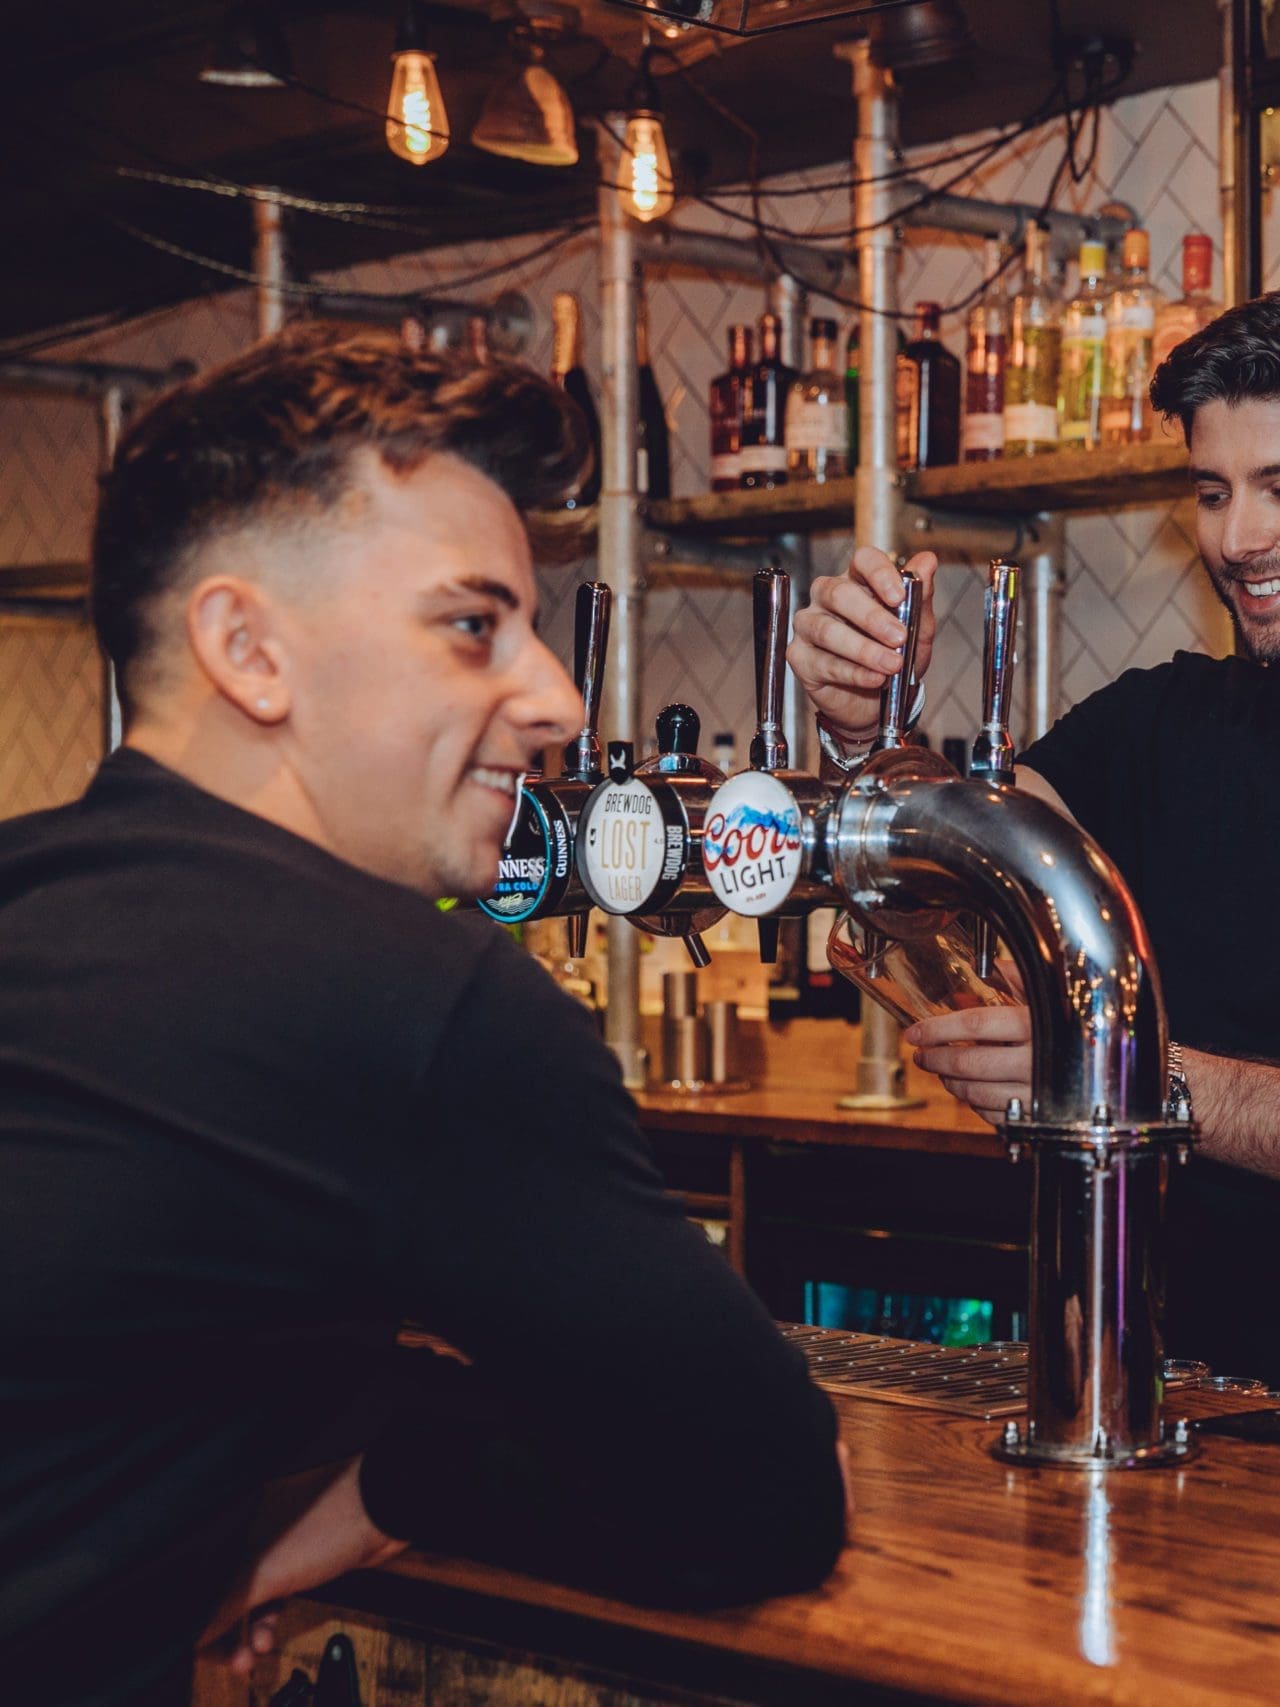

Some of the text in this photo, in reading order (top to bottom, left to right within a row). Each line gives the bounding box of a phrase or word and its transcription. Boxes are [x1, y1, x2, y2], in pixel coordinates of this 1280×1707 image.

[605, 793, 652, 815] BREWDOG
[553, 820, 568, 878] GUINNESS
[601, 819, 651, 871] LOST
[662, 825, 684, 880] BREWDOG
[702, 813, 800, 871] Coors
[498, 857, 545, 879] NNESS
[513, 881, 539, 891] COLD
[720, 856, 786, 894] LIGHT
[608, 875, 642, 901] LAGER
